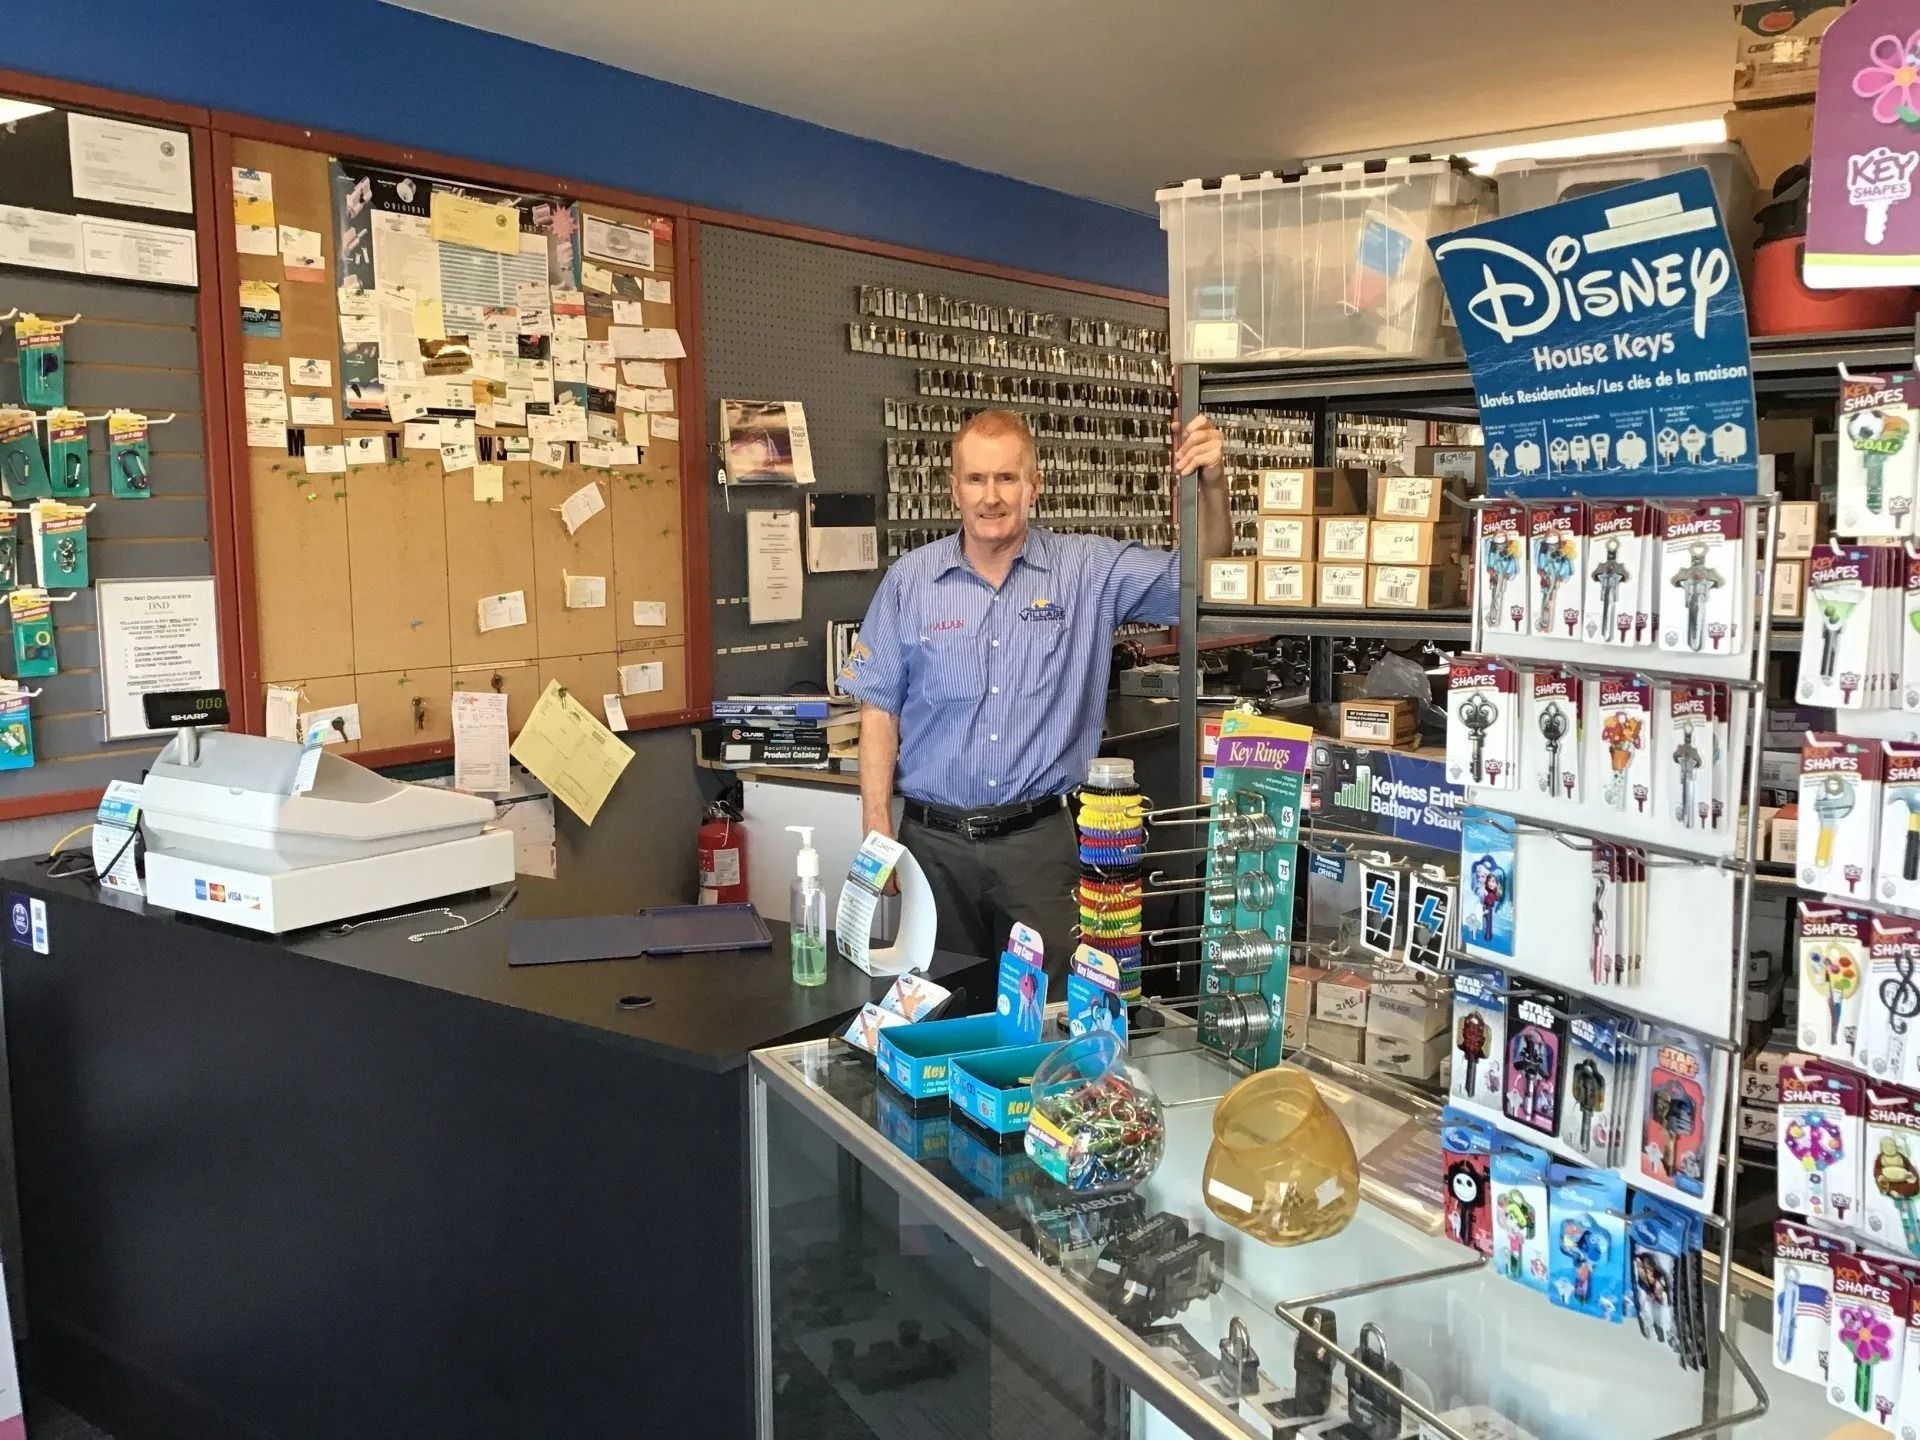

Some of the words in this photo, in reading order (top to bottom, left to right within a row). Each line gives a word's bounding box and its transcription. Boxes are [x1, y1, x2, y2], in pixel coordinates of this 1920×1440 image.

[1851, 155, 1916, 186] KEY
[1853, 183, 1907, 198] SHAPES
[1435, 235, 1730, 343] Disney
[1533, 341, 1608, 373] House
[1614, 331, 1675, 362] Keys
[1627, 371, 1652, 391] clés
[1655, 369, 1673, 387] de
[1676, 367, 1691, 385] la
[1694, 364, 1748, 383] maison
[1844, 382, 1871, 395] KEY
[1844, 389, 1904, 411] SHAPES
[1890, 498, 1910, 509] KEY
[1483, 518, 1517, 535] SHAPES
[1532, 518, 1571, 535] SHAPES
[1594, 517, 1633, 534] SHAPES
[1667, 520, 1722, 538] SHAPES
[1812, 556, 1836, 570] KEY
[1812, 566, 1860, 583] SHAPES
[148, 602, 169, 610] DND
[1511, 607, 1523, 616] KEY
[1564, 610, 1579, 619] KEY
[1618, 614, 1633, 624] KEY
[933, 619, 965, 631] ALAN
[1709, 624, 1727, 634] KEY
[1450, 666, 1472, 678] KEY
[1840, 673, 1860, 684] KEY
[1451, 675, 1496, 688] SHAPES
[1535, 683, 1567, 696] SHAPES
[1602, 691, 1640, 704] SHAPES
[1673, 700, 1704, 715] SHAPES
[171, 713, 208, 721] SHARP
[763, 751, 792, 759] Product
[793, 752, 820, 760] Catalog
[1229, 742, 1253, 767] Key
[1254, 742, 1290, 770] Rings
[1485, 760, 1502, 770] KEY
[1803, 757, 1858, 771] SHAPES
[1888, 768, 1920, 780] SHA
[1372, 775, 1427, 803] Keyless
[1634, 786, 1648, 795] KEY
[1283, 811, 1291, 823] 65
[1371, 796, 1422, 826] Battery
[1316, 855, 1340, 867] Panasonic
[1280, 864, 1288, 873] 75
[228, 891, 242, 902] VISA
[1803, 923, 1858, 936] SHAPES
[1210, 943, 1219, 953] 35
[1077, 963, 1087, 976] Key
[1087, 969, 1116, 990] Identifiers
[1455, 975, 1481, 988] STAR
[1455, 984, 1481, 997] WARS
[1518, 1000, 1552, 1016] STAR
[1518, 1011, 1555, 1028] WARS
[1571, 1019, 1594, 1033] STAR
[1572, 1027, 1595, 1042] WARS
[1659, 1046, 1697, 1064] STAR
[923, 1065, 946, 1080] Key
[1660, 1056, 1699, 1078] WARS
[1783, 1090, 1841, 1105] SHAPES
[1008, 1101, 1031, 1115] Key
[1449, 1131, 1470, 1149] Disney
[1080, 1192, 1135, 1212] ABLOY
[1776, 1245, 1829, 1265] SHAPES
[1836, 1266, 1862, 1282] KEY
[1835, 1279, 1891, 1303] SHAPES
